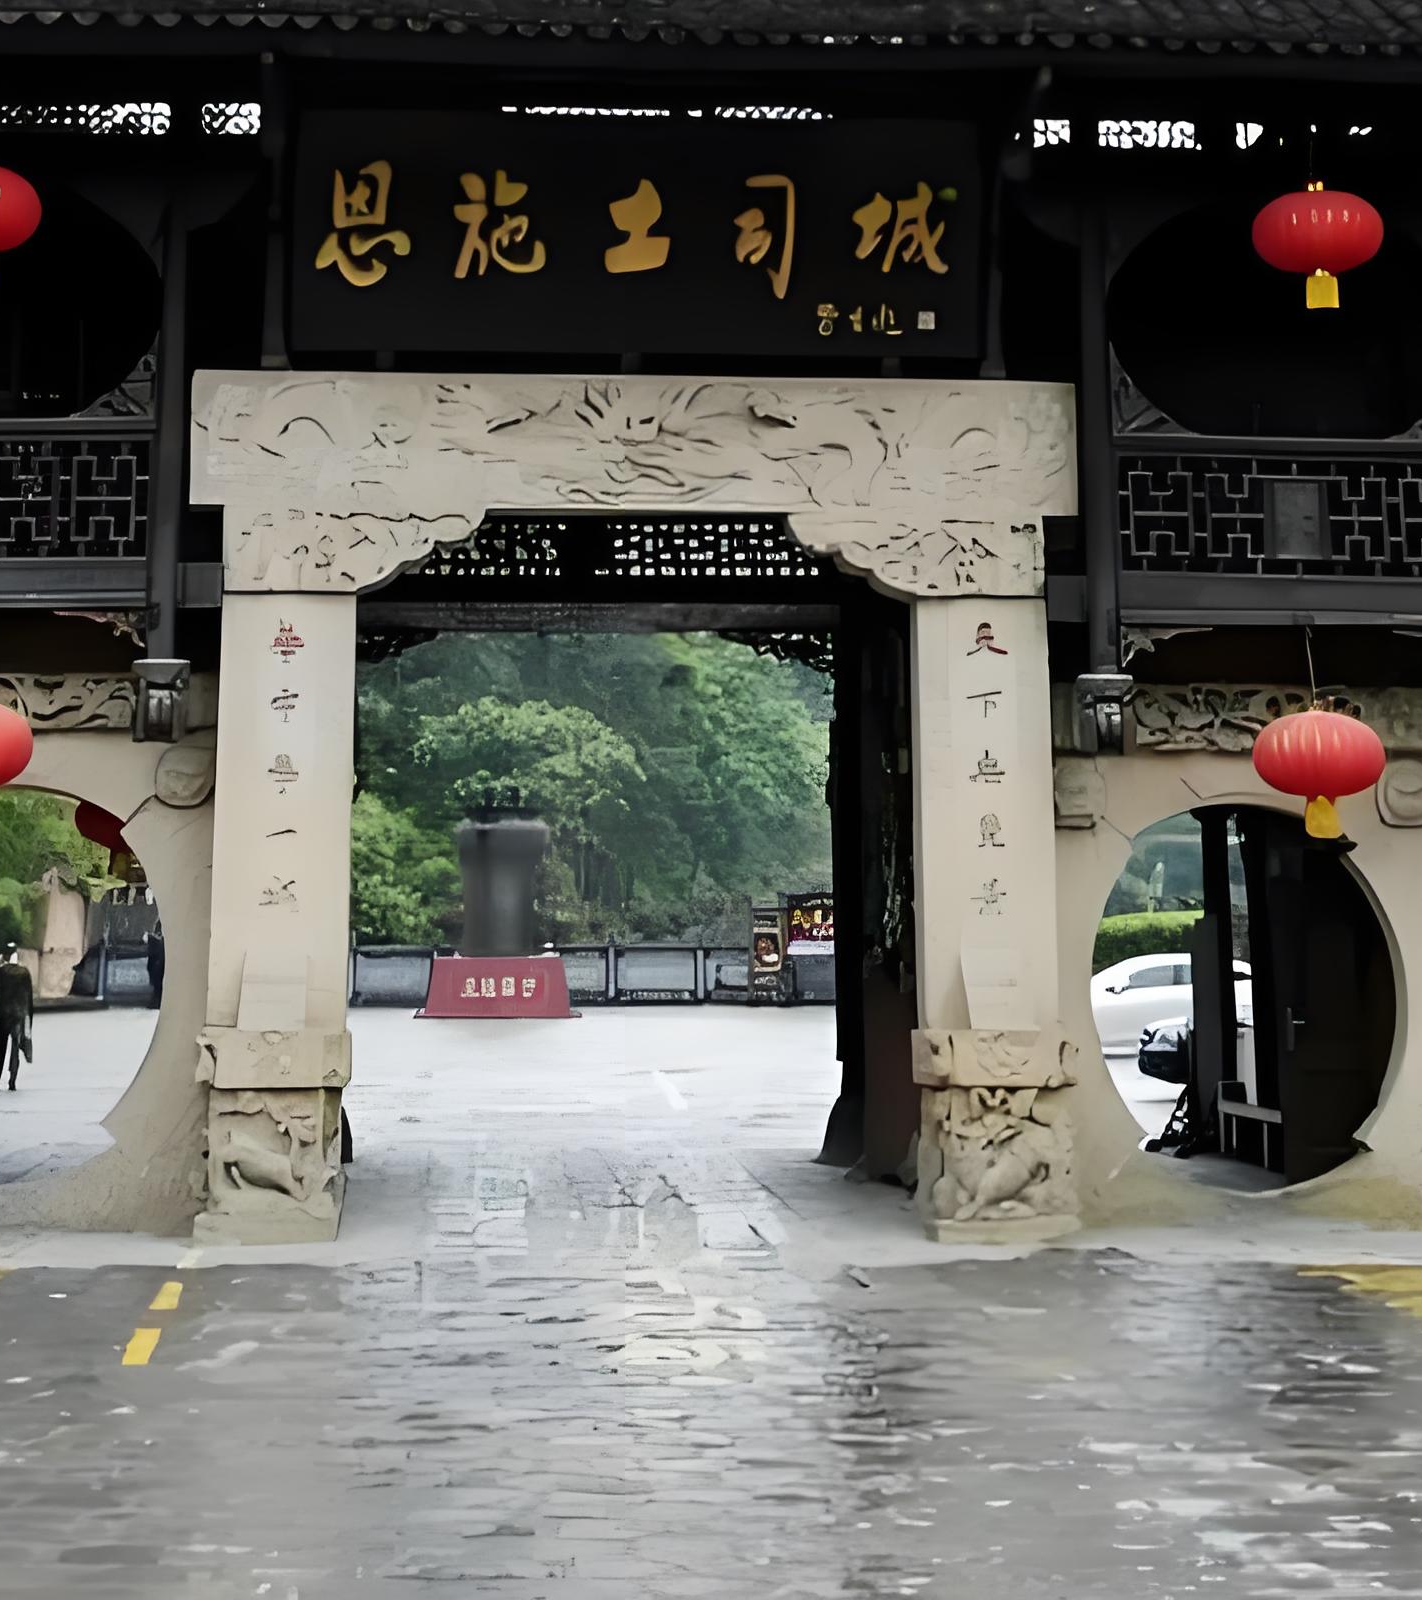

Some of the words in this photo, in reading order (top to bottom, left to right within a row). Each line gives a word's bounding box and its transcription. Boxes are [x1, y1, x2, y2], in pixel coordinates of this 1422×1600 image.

[315, 160, 949, 299] 恩施土司城
